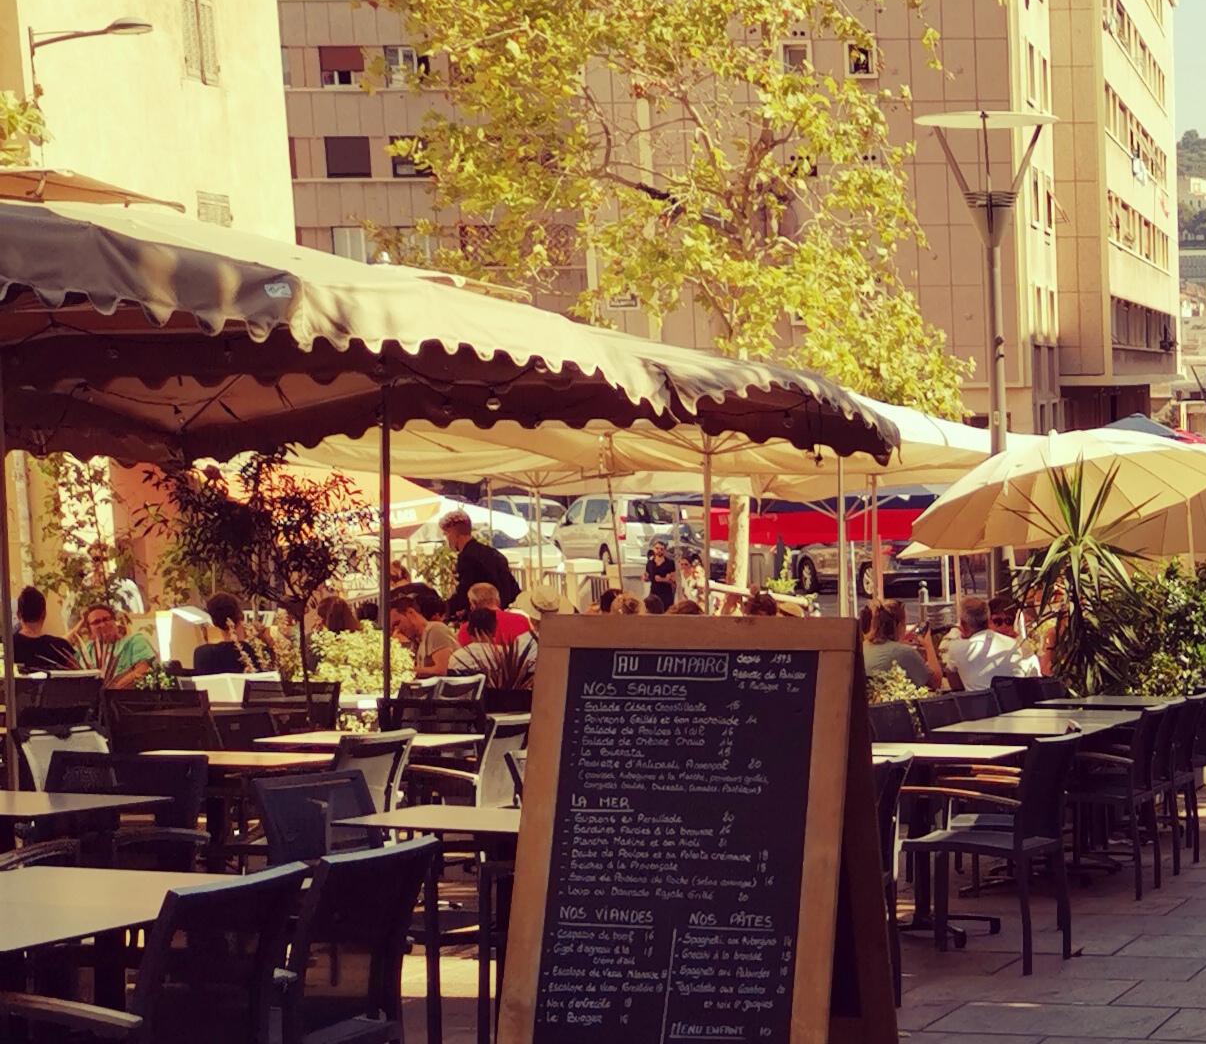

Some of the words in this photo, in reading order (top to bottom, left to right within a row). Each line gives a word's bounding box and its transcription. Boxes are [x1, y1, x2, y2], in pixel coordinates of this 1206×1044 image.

[617, 655, 639, 673] AU
[764, 669, 777, 679] de
[583, 680, 617, 695] NOS
[626, 682, 688, 696] SALADES
[584, 701, 620, 712] Salade
[660, 716, 671, 724] et
[584, 724, 617, 735] Salade
[621, 725, 634, 735] de
[581, 735, 615, 746] Salade
[618, 736, 632, 746] de
[572, 793, 587, 808] LA
[599, 796, 631, 810] MER
[665, 826, 676, 835] la
[601, 847, 614, 858] de
[559, 905, 588, 919] NOS
[595, 906, 654, 924] VIANDES
[689, 910, 718, 926] NOS
[729, 910, 773, 928] PÂTES
[670, 1021, 703, 1035] MENU
